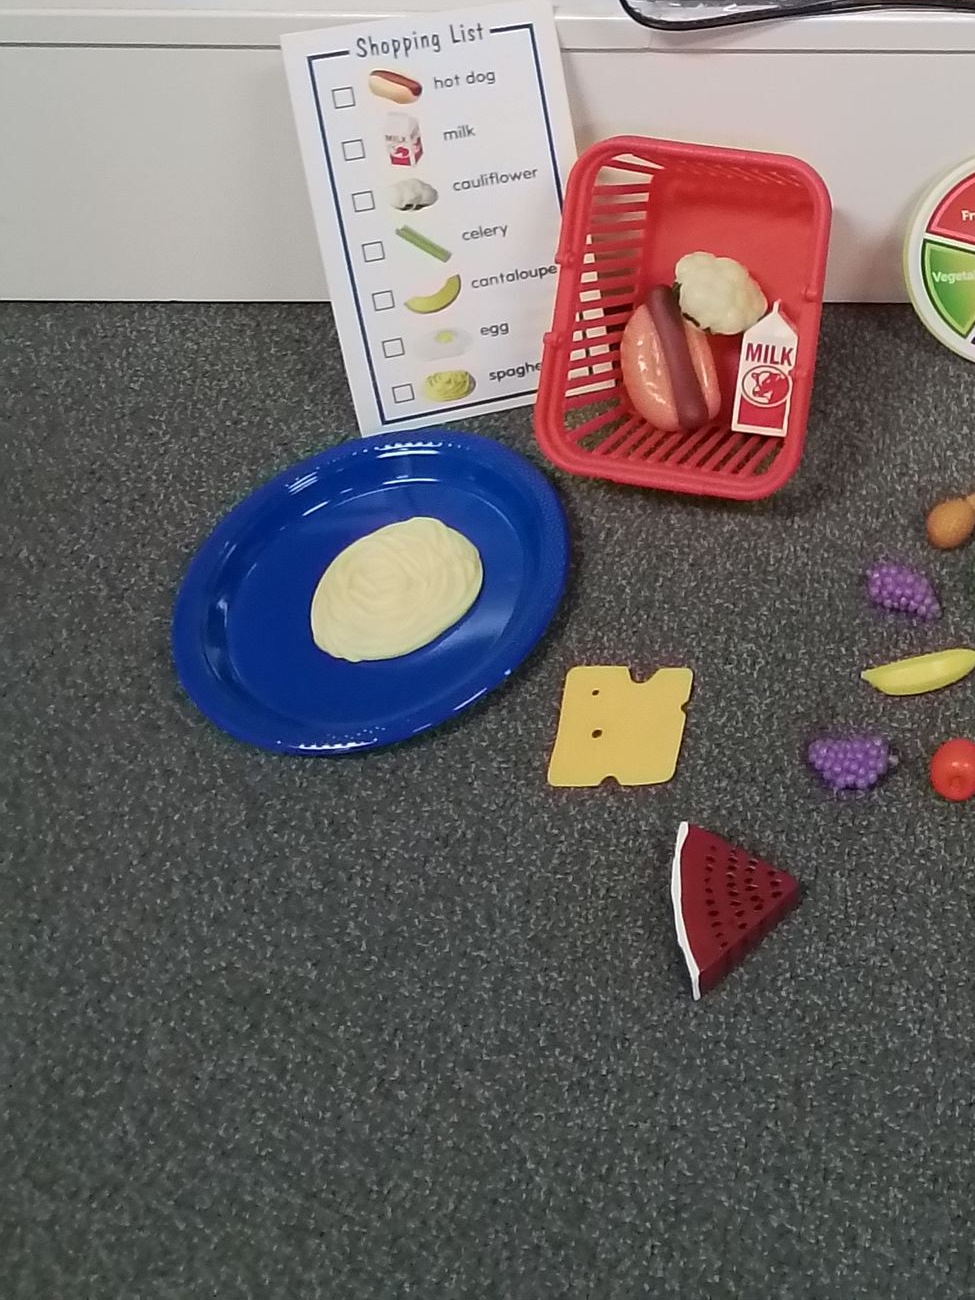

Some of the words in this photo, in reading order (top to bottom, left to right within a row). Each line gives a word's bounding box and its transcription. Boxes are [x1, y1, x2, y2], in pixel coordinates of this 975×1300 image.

[356, 31, 442, 59] Shopping
[449, 22, 484, 44] List
[433, 74, 460, 90] hot
[466, 69, 496, 84] dog
[443, 124, 476, 141] milk
[452, 168, 539, 192] cauliflower
[462, 225, 508, 241] celery
[471, 264, 557, 289] cantaloupe
[480, 322, 509, 337] egg
[745, 342, 794, 367] MILK
